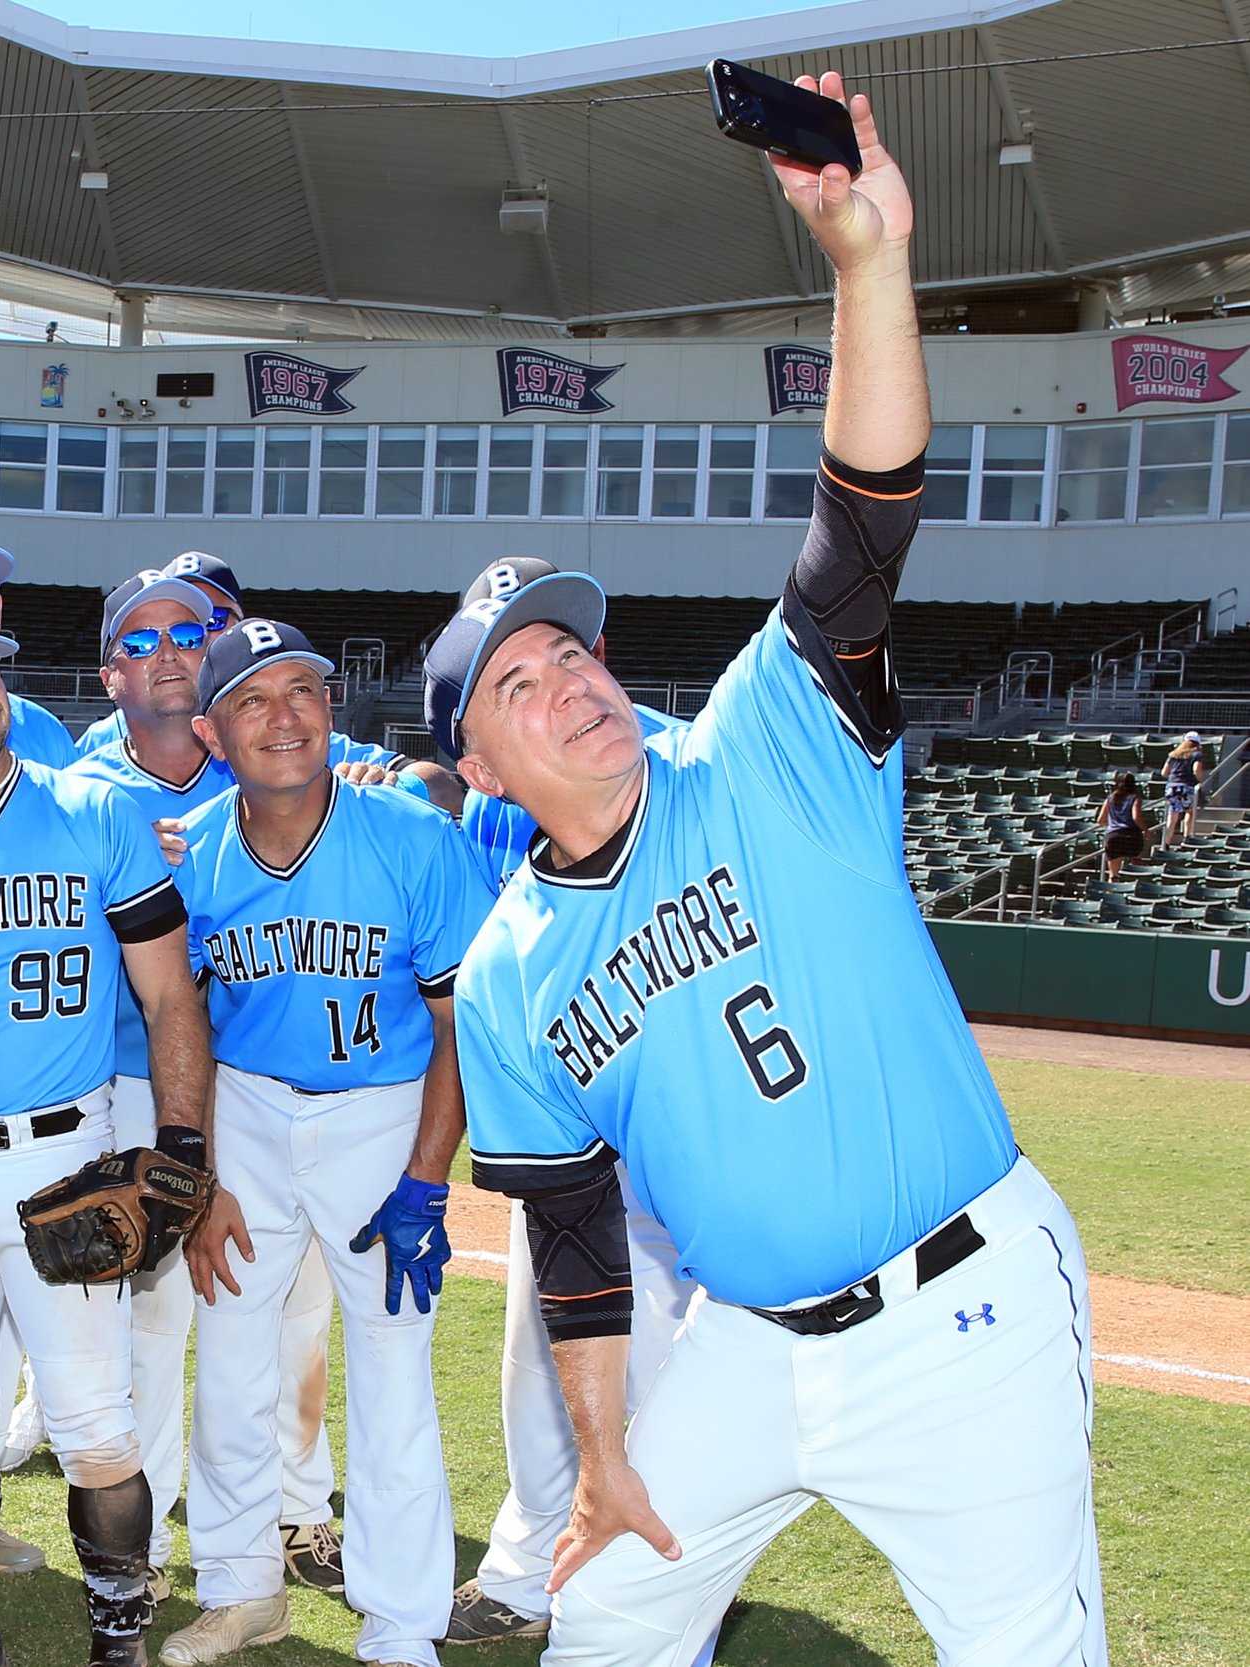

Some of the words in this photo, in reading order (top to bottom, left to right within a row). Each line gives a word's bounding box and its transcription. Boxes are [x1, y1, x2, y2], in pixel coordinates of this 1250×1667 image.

[516, 355, 554, 368] AMERICAN
[555, 362, 584, 375] LEAGUE
[785, 353, 825, 365] AMERICAN
[1132, 343, 1169, 354] WORLD
[1171, 346, 1207, 360] SERIES
[261, 367, 329, 401] 1967
[262, 359, 298, 371] AMERICAN
[299, 365, 326, 377] LEAGUE
[515, 363, 586, 400] 1975
[783, 362, 832, 394] 198
[1127, 353, 1208, 388] 2004
[265, 395, 323, 411] CHAMPIONS
[518, 392, 580, 410] CHAMPIONS
[787, 391, 829, 405] CHAMP
[1135, 383, 1202, 399] CHAMPIONS
[175, 553, 201, 576] B
[486, 564, 520, 599] B
[241, 621, 283, 655] B
[203, 915, 389, 984] BALTIMORE
[10, 944, 91, 1023] 99
[1208, 949, 1250, 1007] U
[324, 991, 382, 1063] 14
[720, 980, 810, 1103] 6
[148, 1169, 196, 1195] Wilson
